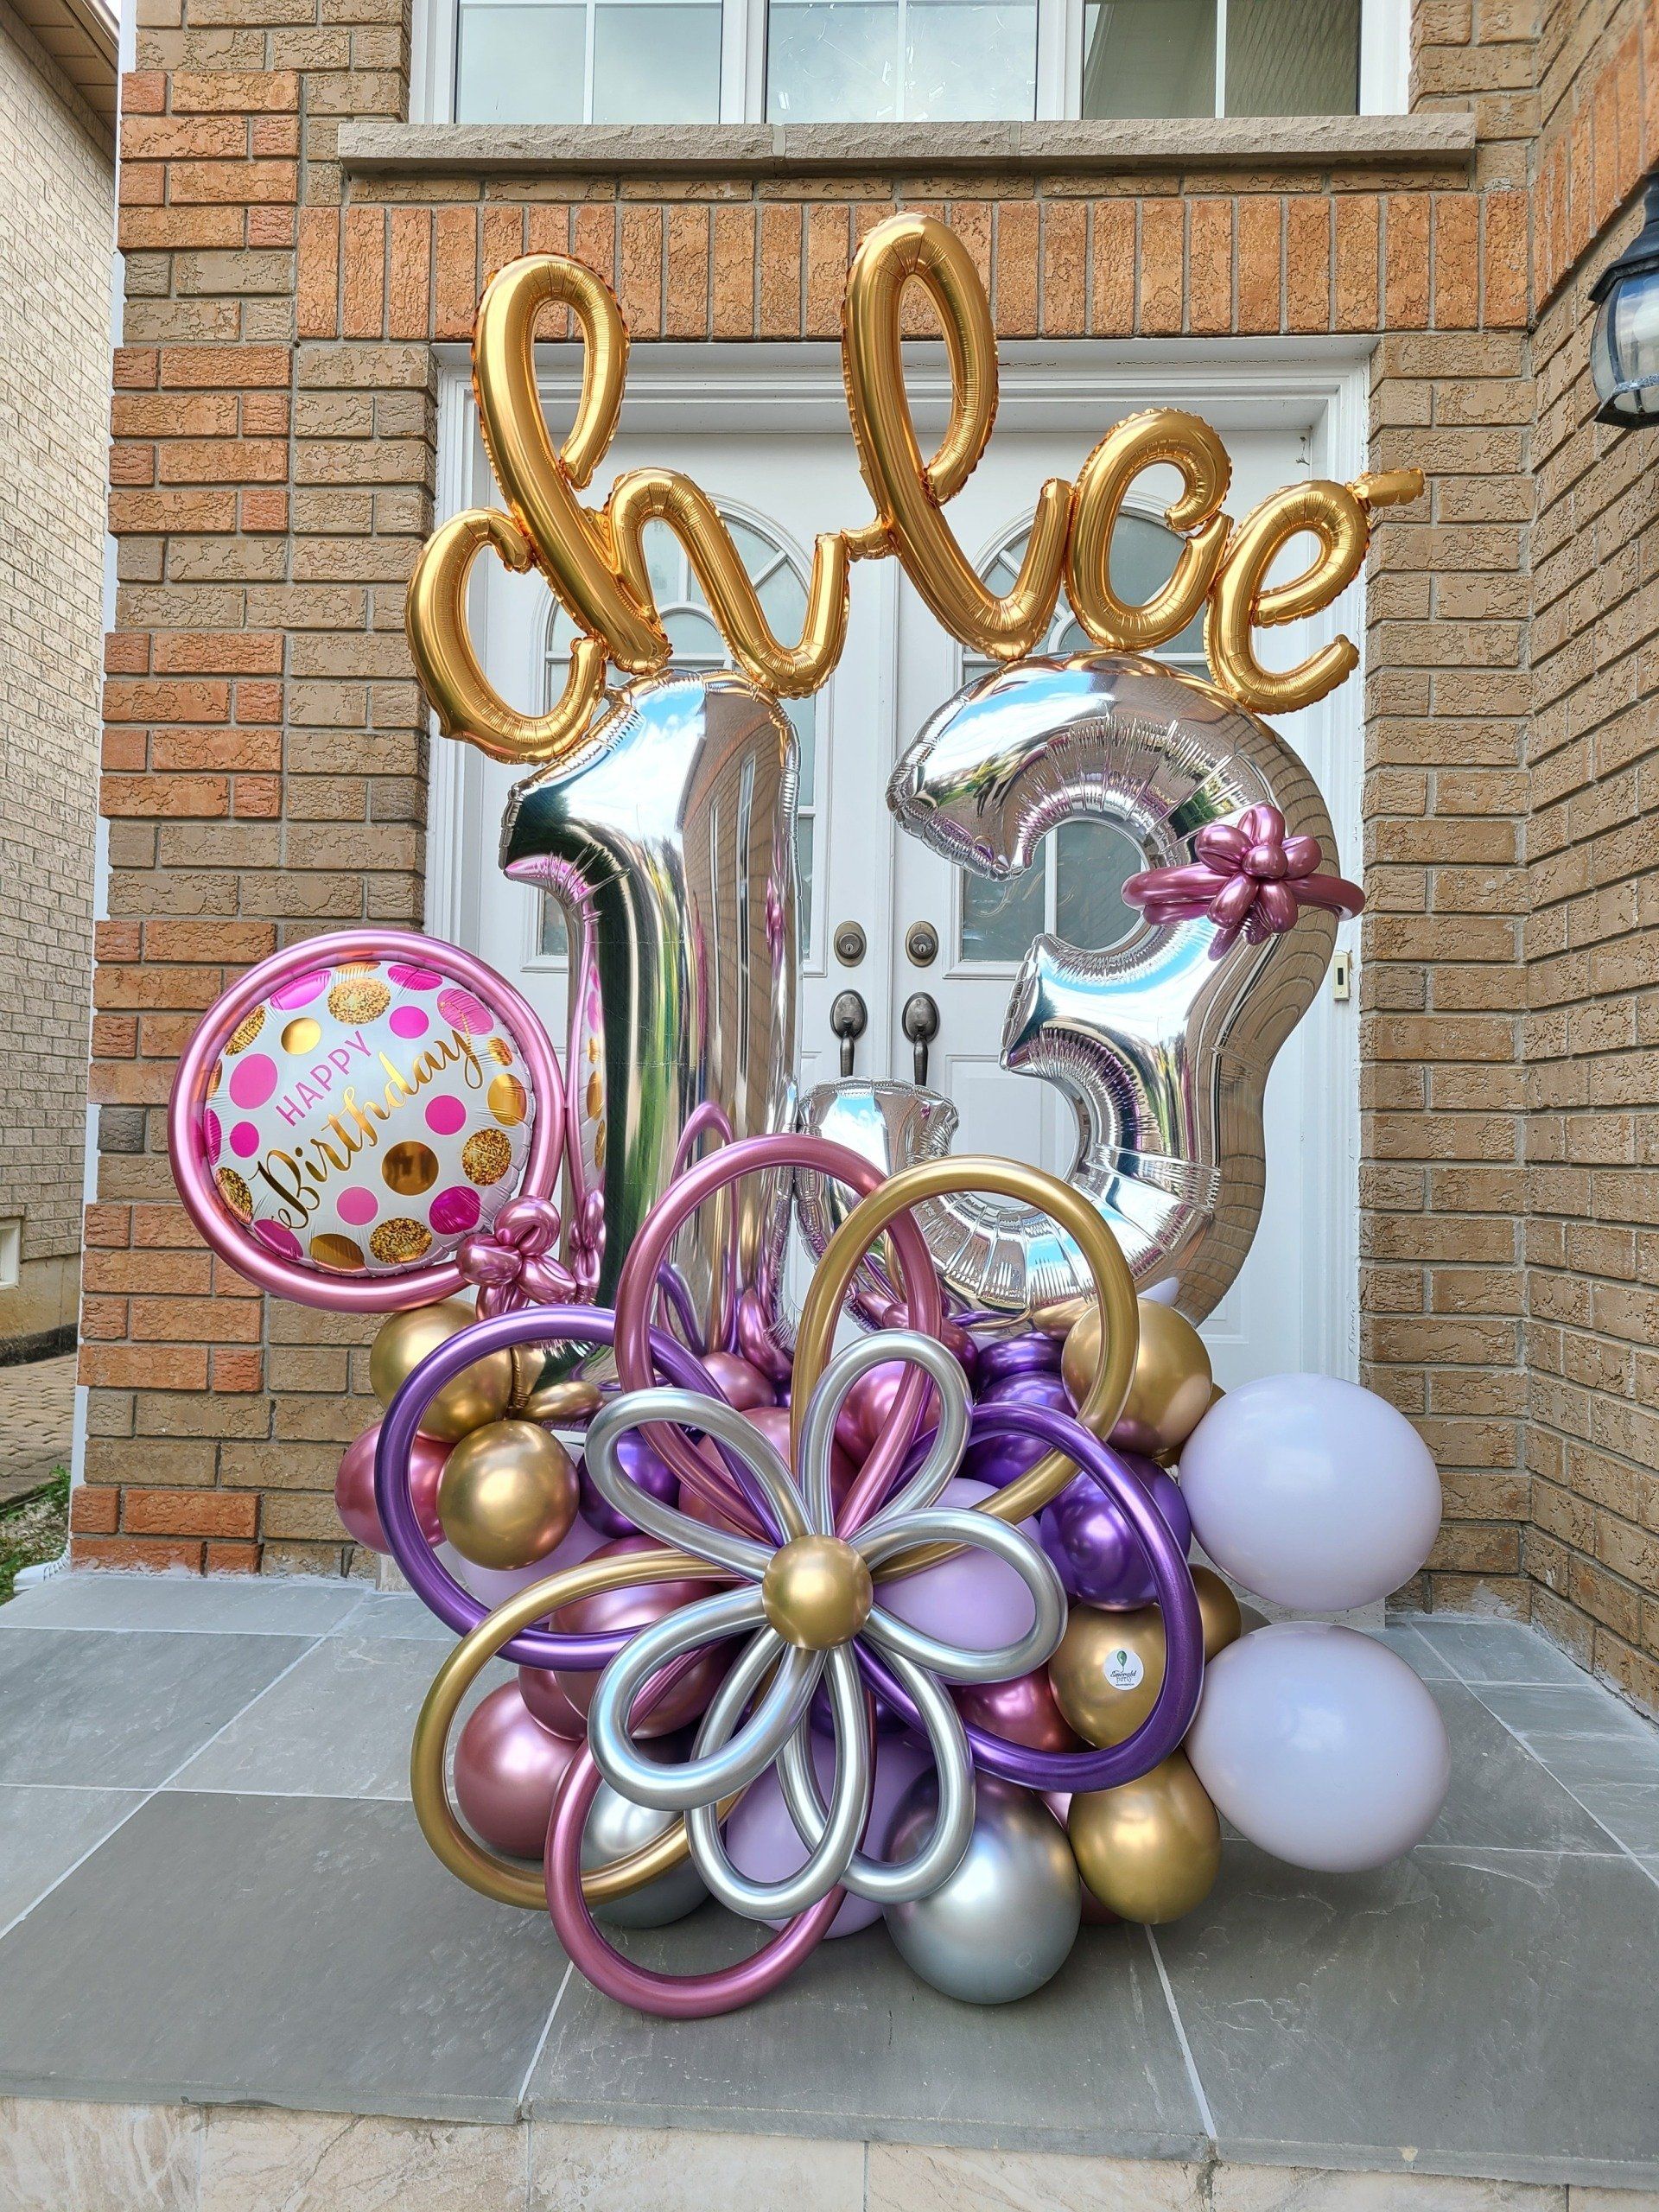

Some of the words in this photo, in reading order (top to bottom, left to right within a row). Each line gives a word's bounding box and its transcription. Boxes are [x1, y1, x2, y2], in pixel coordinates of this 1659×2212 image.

[247, 1002, 484, 1230] Birthday
[275, 1030, 372, 1127] HAPPY
[499, 653, 1337, 1374] 13
